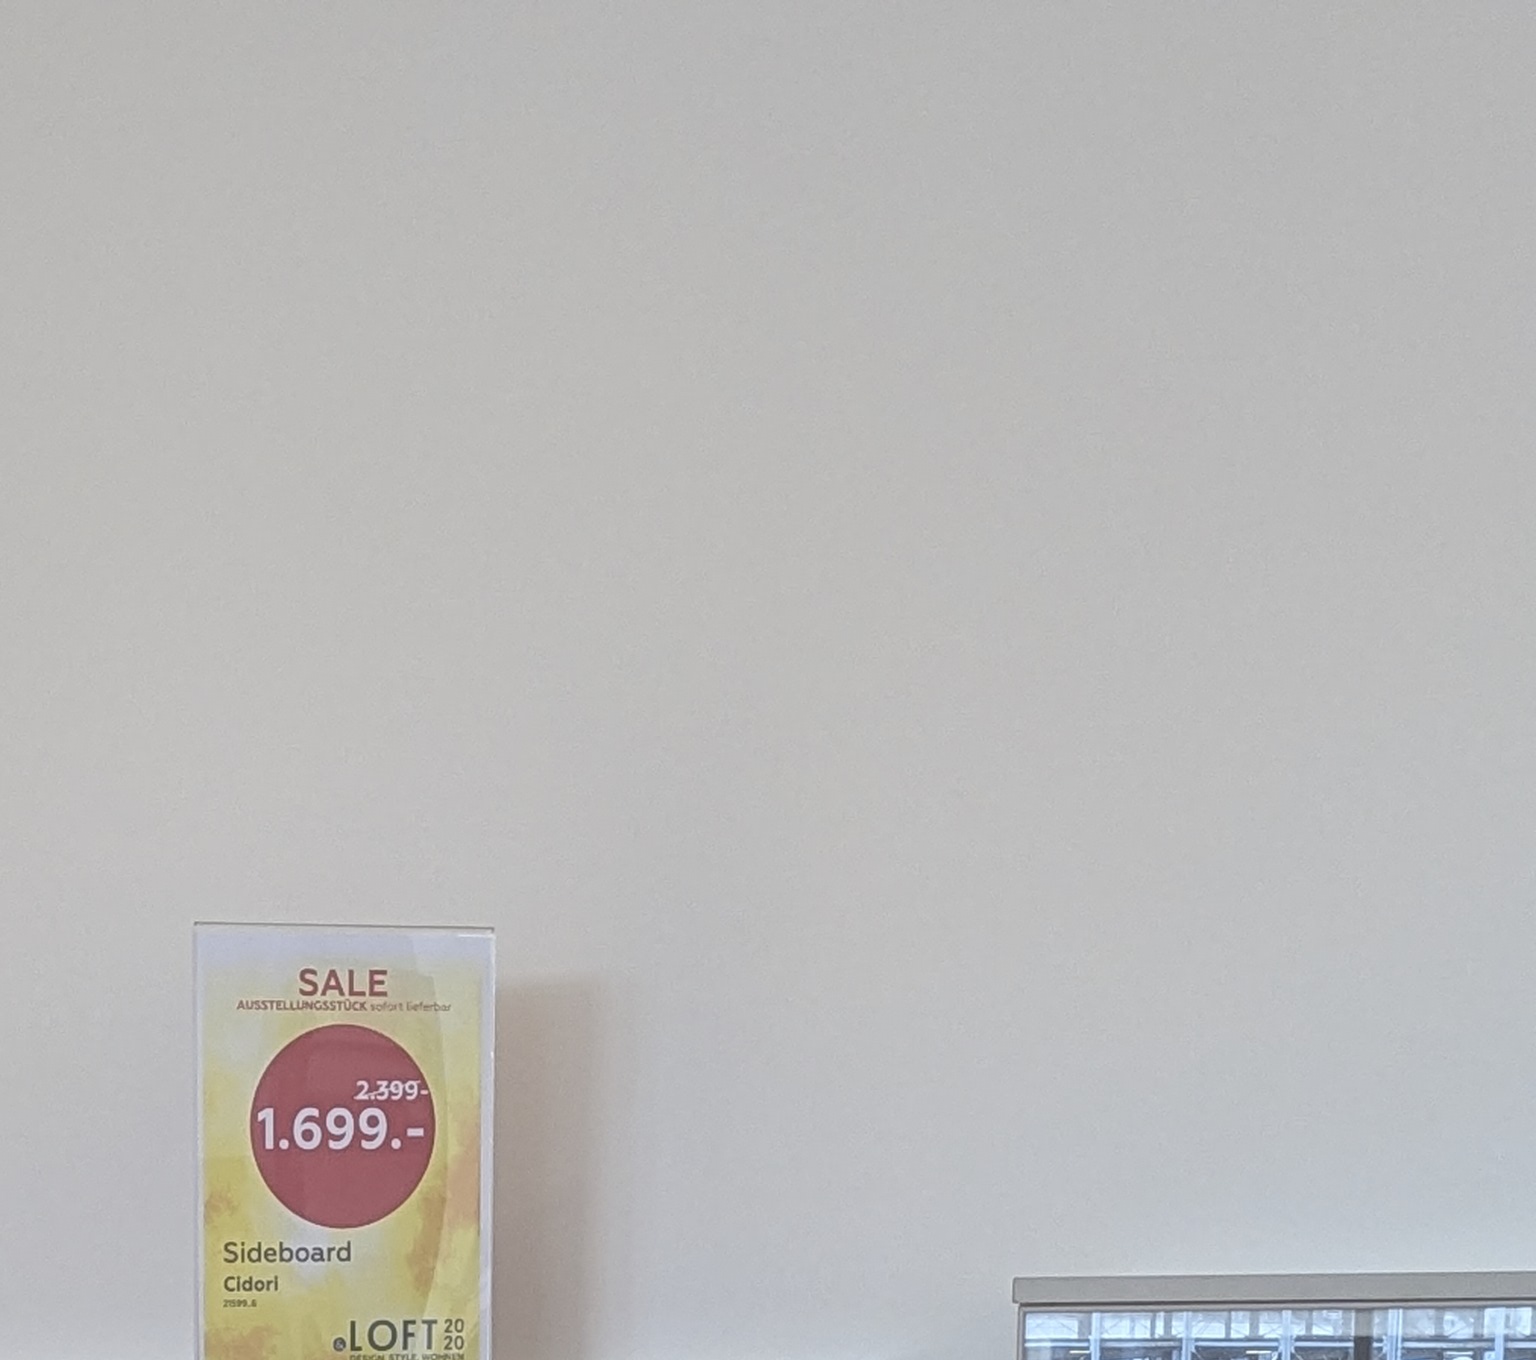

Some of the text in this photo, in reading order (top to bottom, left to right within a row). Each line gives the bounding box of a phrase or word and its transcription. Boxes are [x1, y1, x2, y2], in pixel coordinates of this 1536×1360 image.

[298, 968, 388, 997] SALE
[236, 998, 451, 1012] AUSSTELLUNGSSTÜCK sofort lieferbar
[257, 1107, 424, 1150] 1.699.-
[223, 1241, 351, 1263] Sideboard
[224, 1275, 278, 1292] Cidori
[350, 1319, 438, 1351] LOFT
[444, 1318, 464, 1333] 20
[444, 1335, 464, 1350] 20
